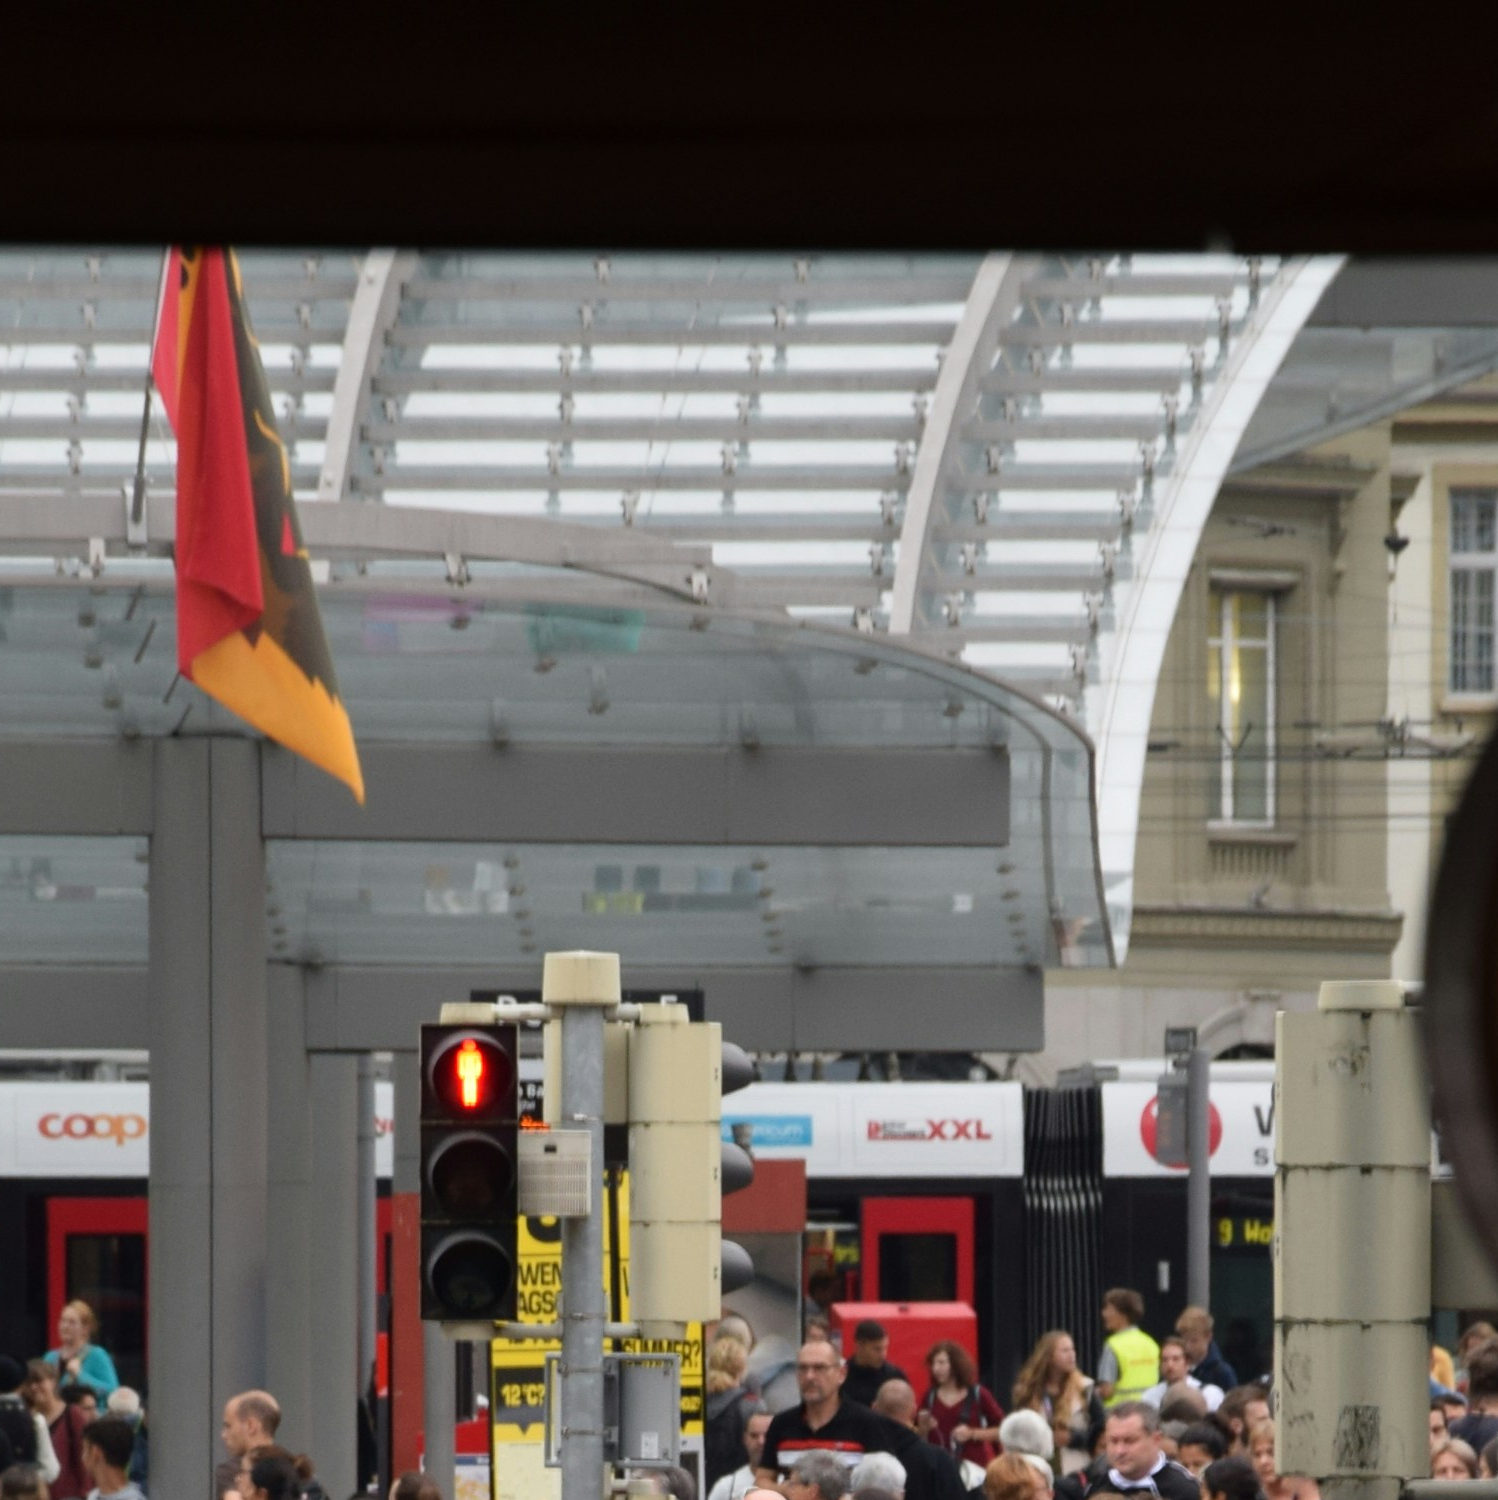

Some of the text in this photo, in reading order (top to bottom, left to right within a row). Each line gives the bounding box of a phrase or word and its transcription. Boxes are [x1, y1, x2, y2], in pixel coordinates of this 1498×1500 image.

[37, 1112, 147, 1147] coop
[925, 1119, 992, 1141] XXL
[1219, 1218, 1232, 1246] 9
